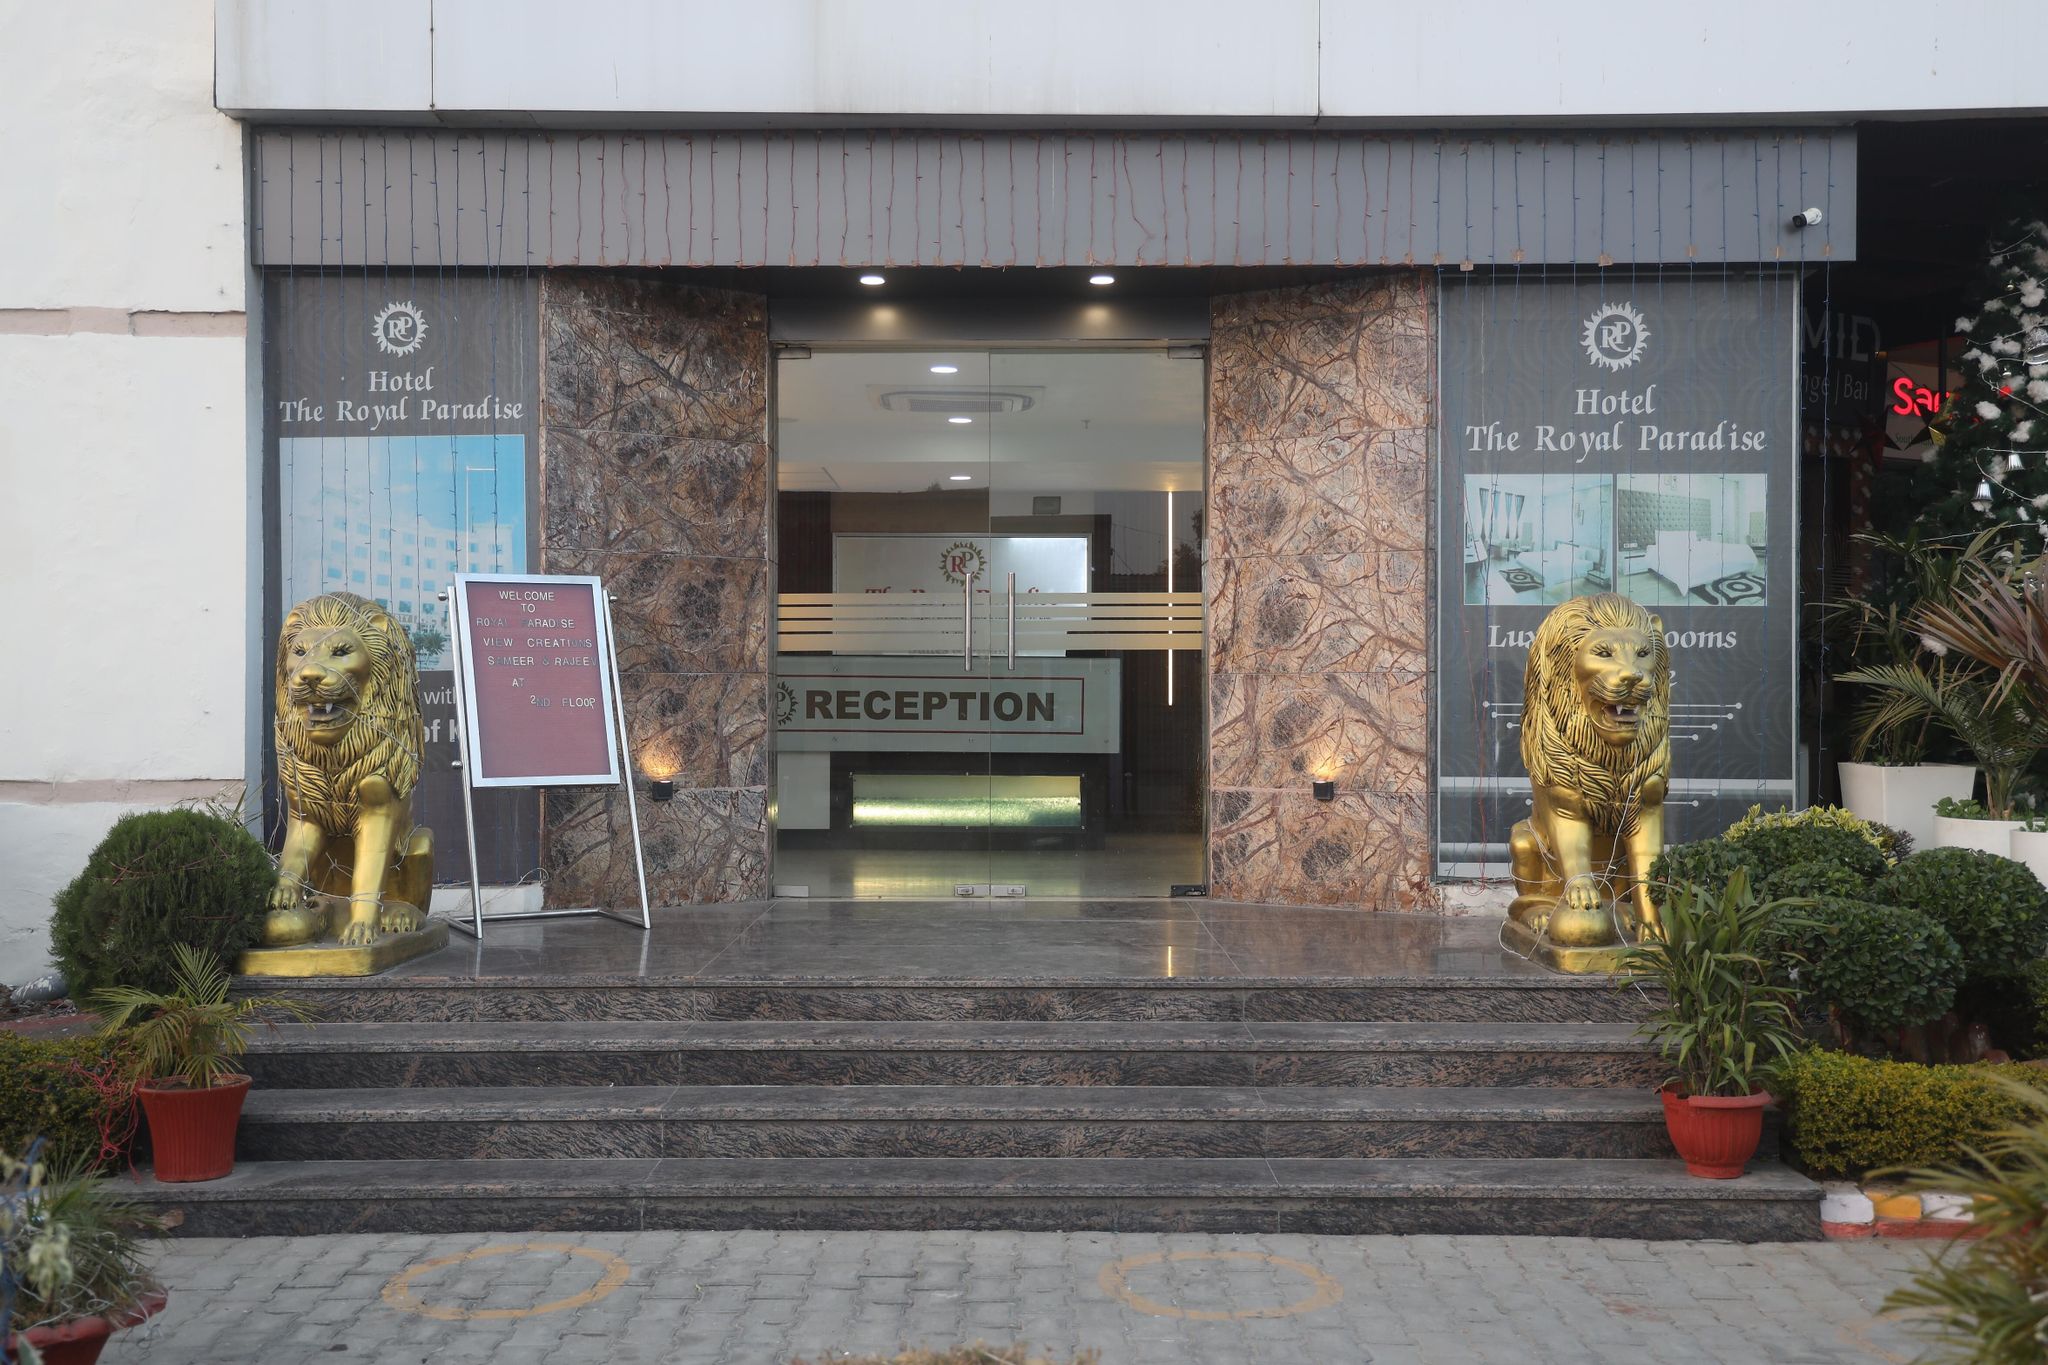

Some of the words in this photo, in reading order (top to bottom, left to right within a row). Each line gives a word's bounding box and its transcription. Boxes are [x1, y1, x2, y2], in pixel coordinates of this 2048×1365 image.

[368, 366, 435, 392] Hotel
[279, 397, 326, 423] The
[335, 396, 409, 431] Royal
[421, 394, 525, 422] Paradise
[1574, 384, 1657, 416] Hotel
[1465, 420, 1521, 452] The
[1533, 420, 1624, 464] Royal
[1639, 419, 1768, 452] Paradise
[521, 603, 536, 613] TO
[483, 637, 513, 648] VIEW
[1664, 630, 1738, 649] ooms
[512, 677, 525, 688] AT
[805, 689, 1056, 722] RECEPTION
